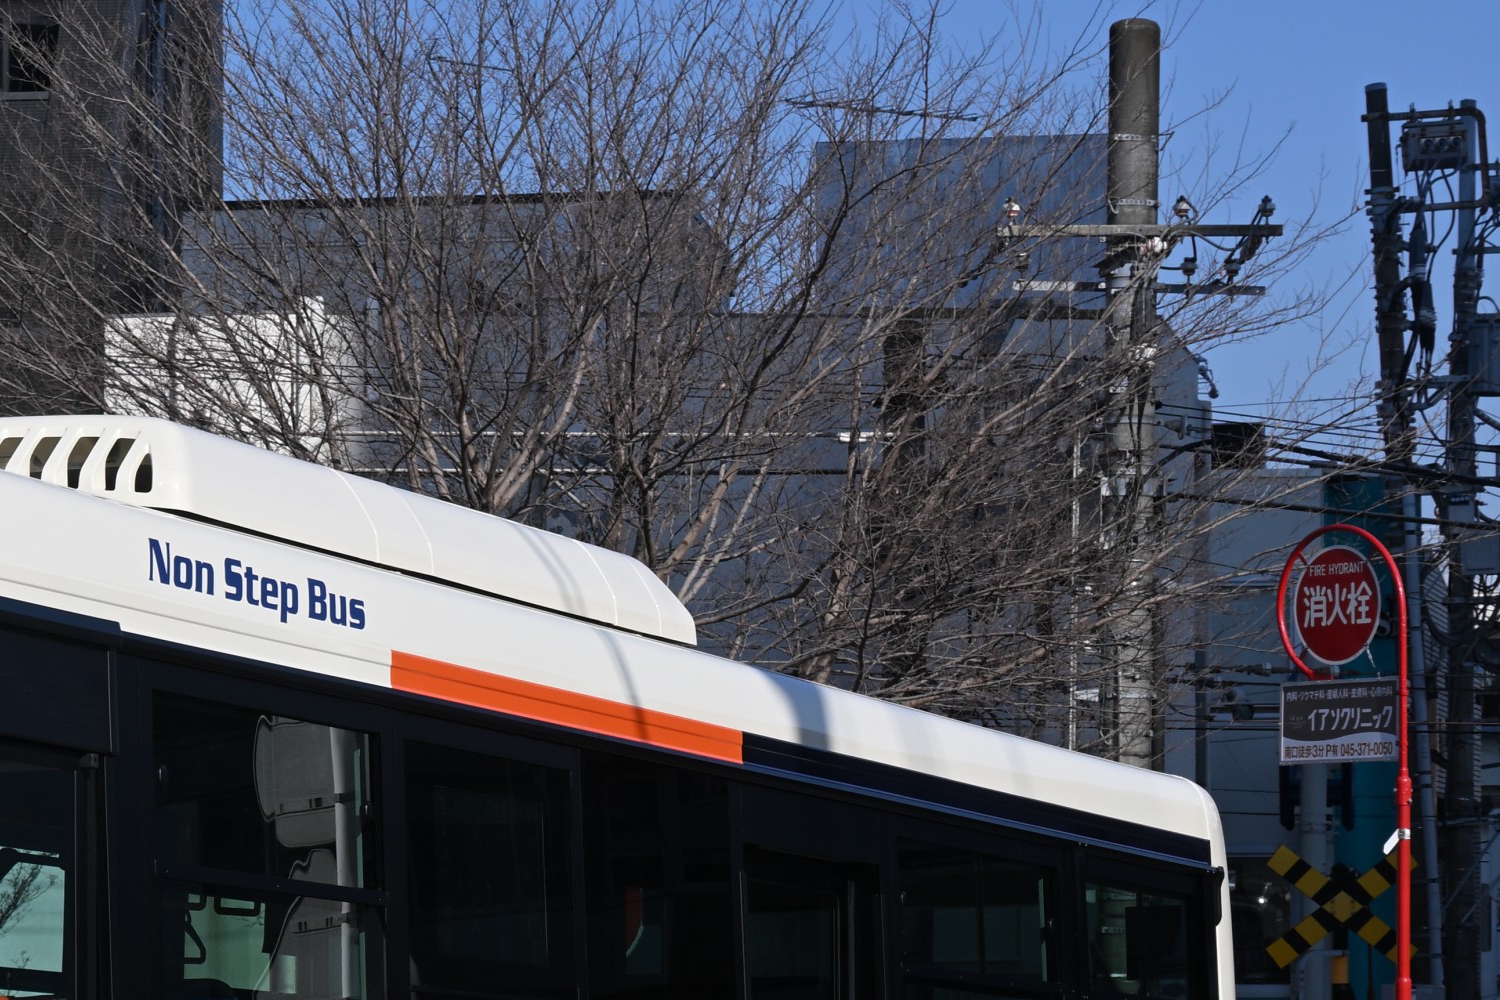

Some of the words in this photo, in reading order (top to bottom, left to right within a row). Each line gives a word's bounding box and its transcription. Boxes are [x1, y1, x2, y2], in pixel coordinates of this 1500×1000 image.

[1309, 564, 1326, 576] FIRE
[1329, 561, 1365, 575] HYDRANT
[148, 537, 215, 596] Non
[224, 557, 299, 624] Step
[307, 577, 366, 631] Bus
[1303, 580, 1373, 628] 消火栓
[1308, 705, 1393, 731] イアソクリニック
[1341, 742, 1393, 757] 045-371-0050
